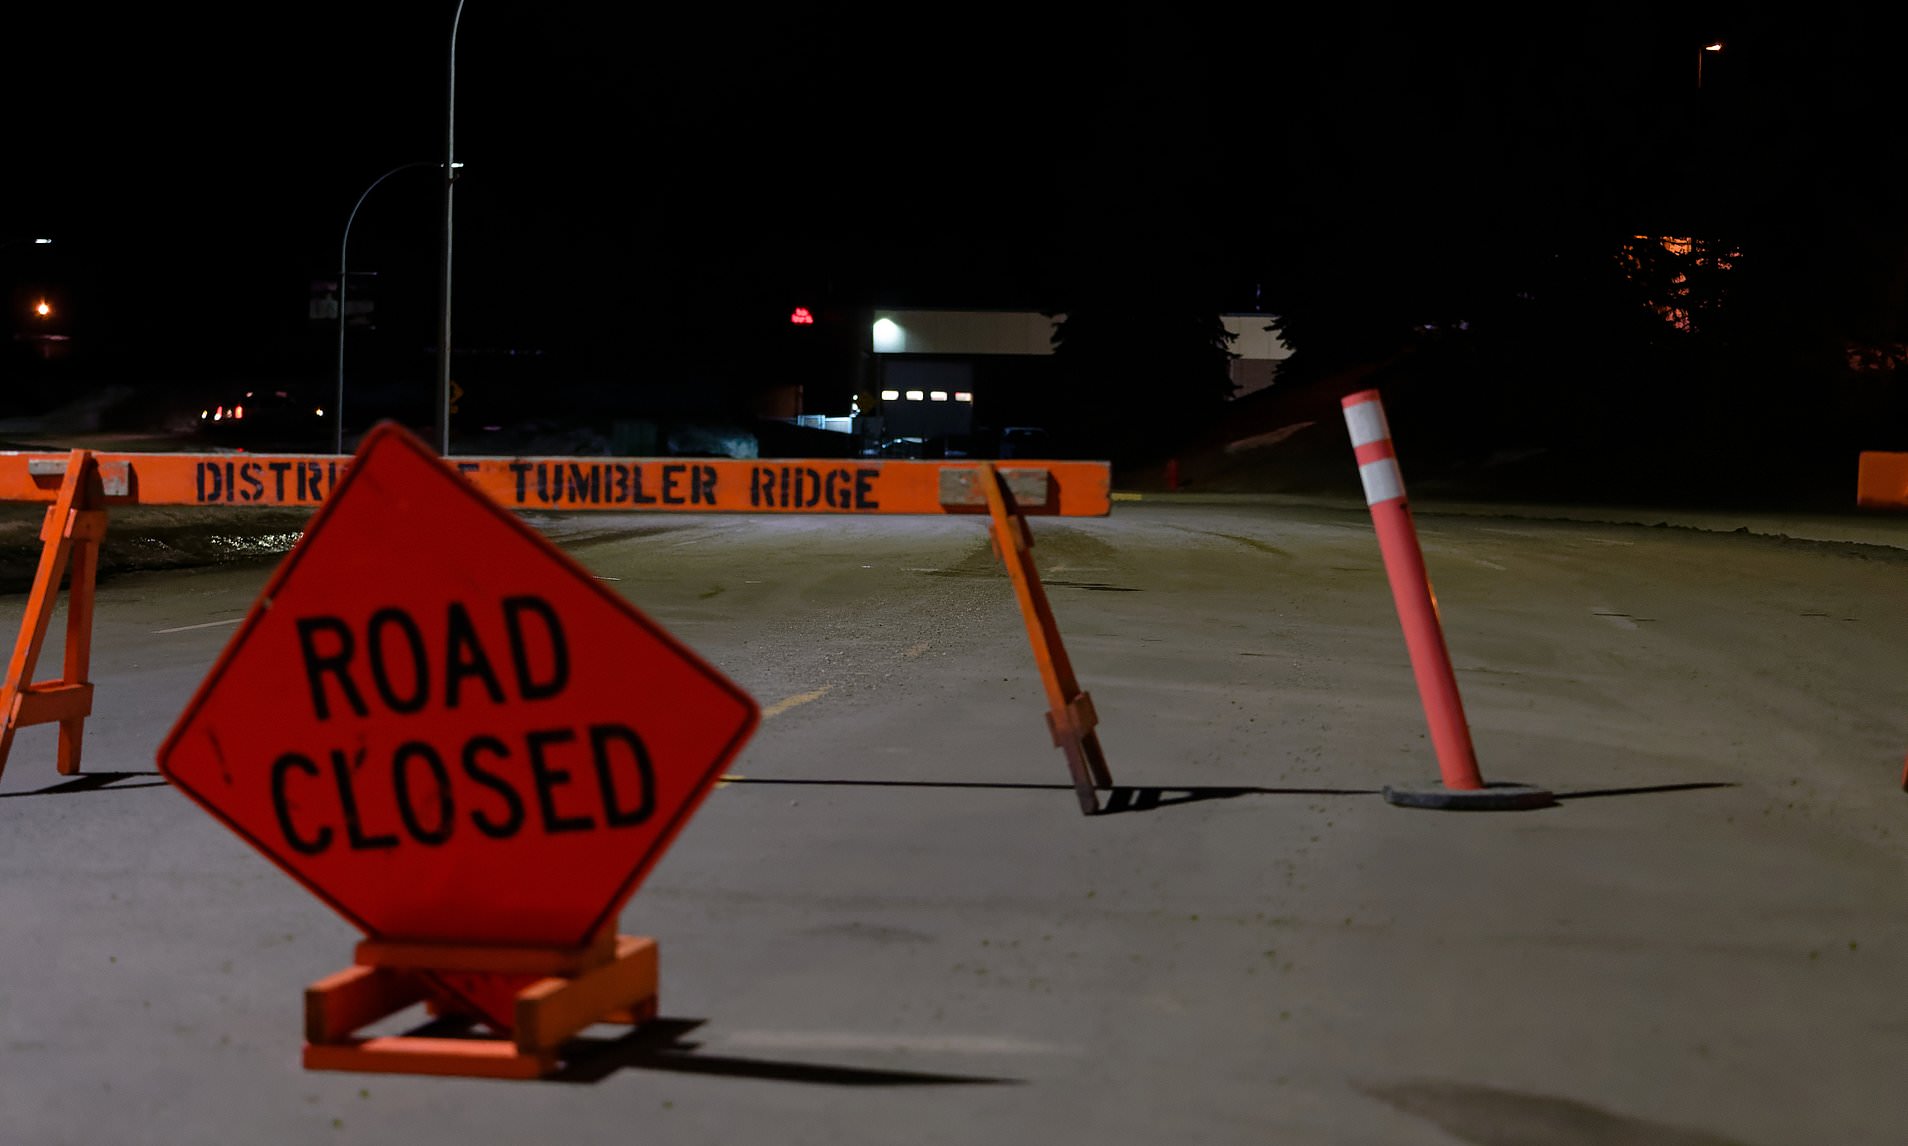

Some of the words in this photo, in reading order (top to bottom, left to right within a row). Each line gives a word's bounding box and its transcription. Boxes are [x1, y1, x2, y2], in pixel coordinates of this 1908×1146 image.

[197, 462, 336, 501] DISTRI
[510, 463, 717, 505] TUMBLER
[751, 467, 880, 509] RIDGE
[296, 595, 570, 721] ROAD
[271, 724, 656, 856] CLOSED
